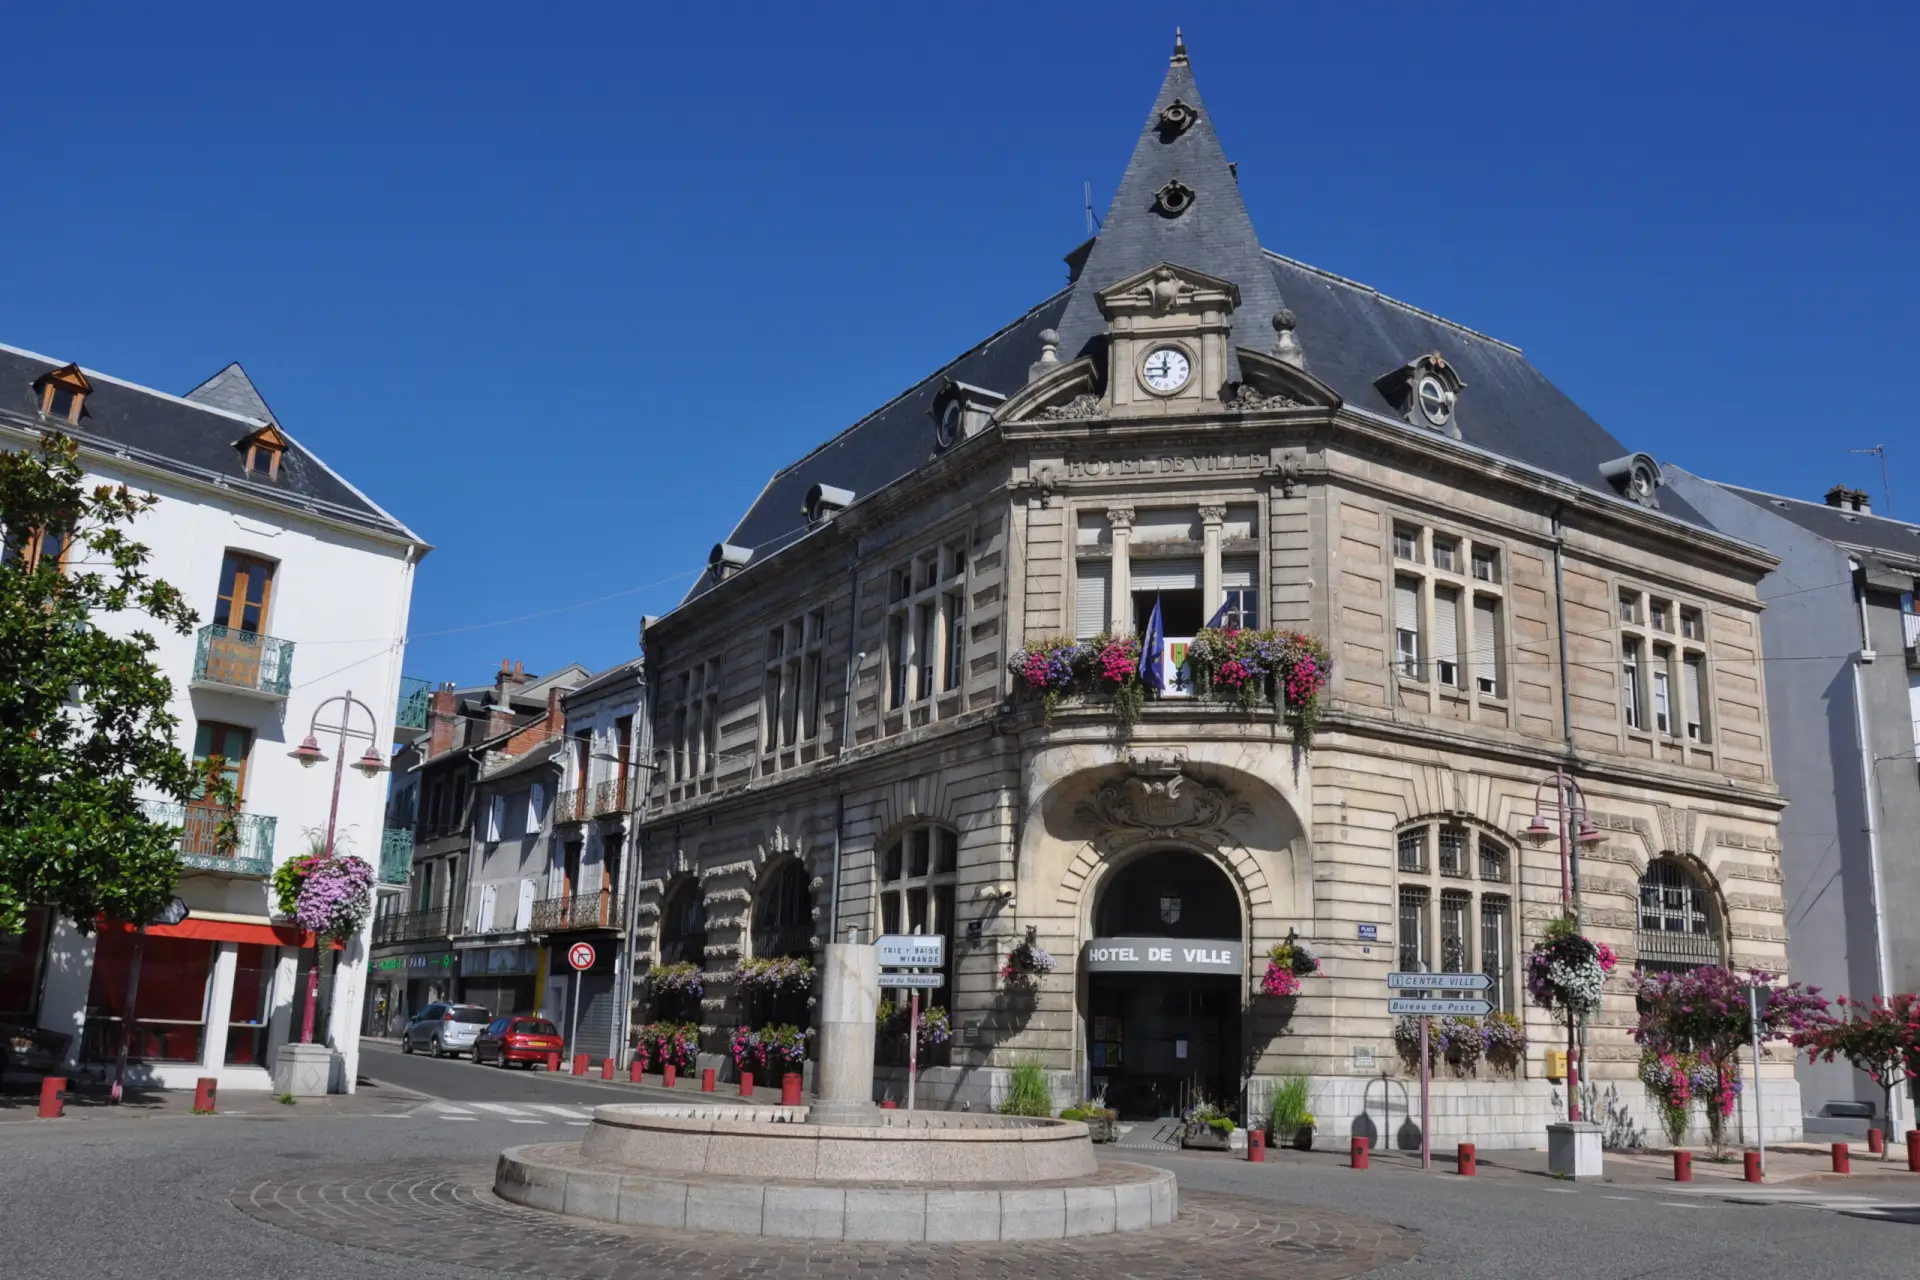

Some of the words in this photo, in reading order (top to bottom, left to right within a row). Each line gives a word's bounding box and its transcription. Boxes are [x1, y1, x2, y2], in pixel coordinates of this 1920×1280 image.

[1160, 456, 1185, 473] DE
[1192, 453, 1267, 472] VILLE
[1089, 947, 1139, 962] HOTEL
[1148, 947, 1172, 962] DE
[1183, 949, 1232, 964] VILLE
[1405, 977, 1444, 985] CENTRE
[1450, 977, 1476, 986] VILLE
[1392, 1002, 1427, 1011] Bureau
[1432, 1003, 1443, 1011] de
[1448, 1003, 1476, 1012] Poste
